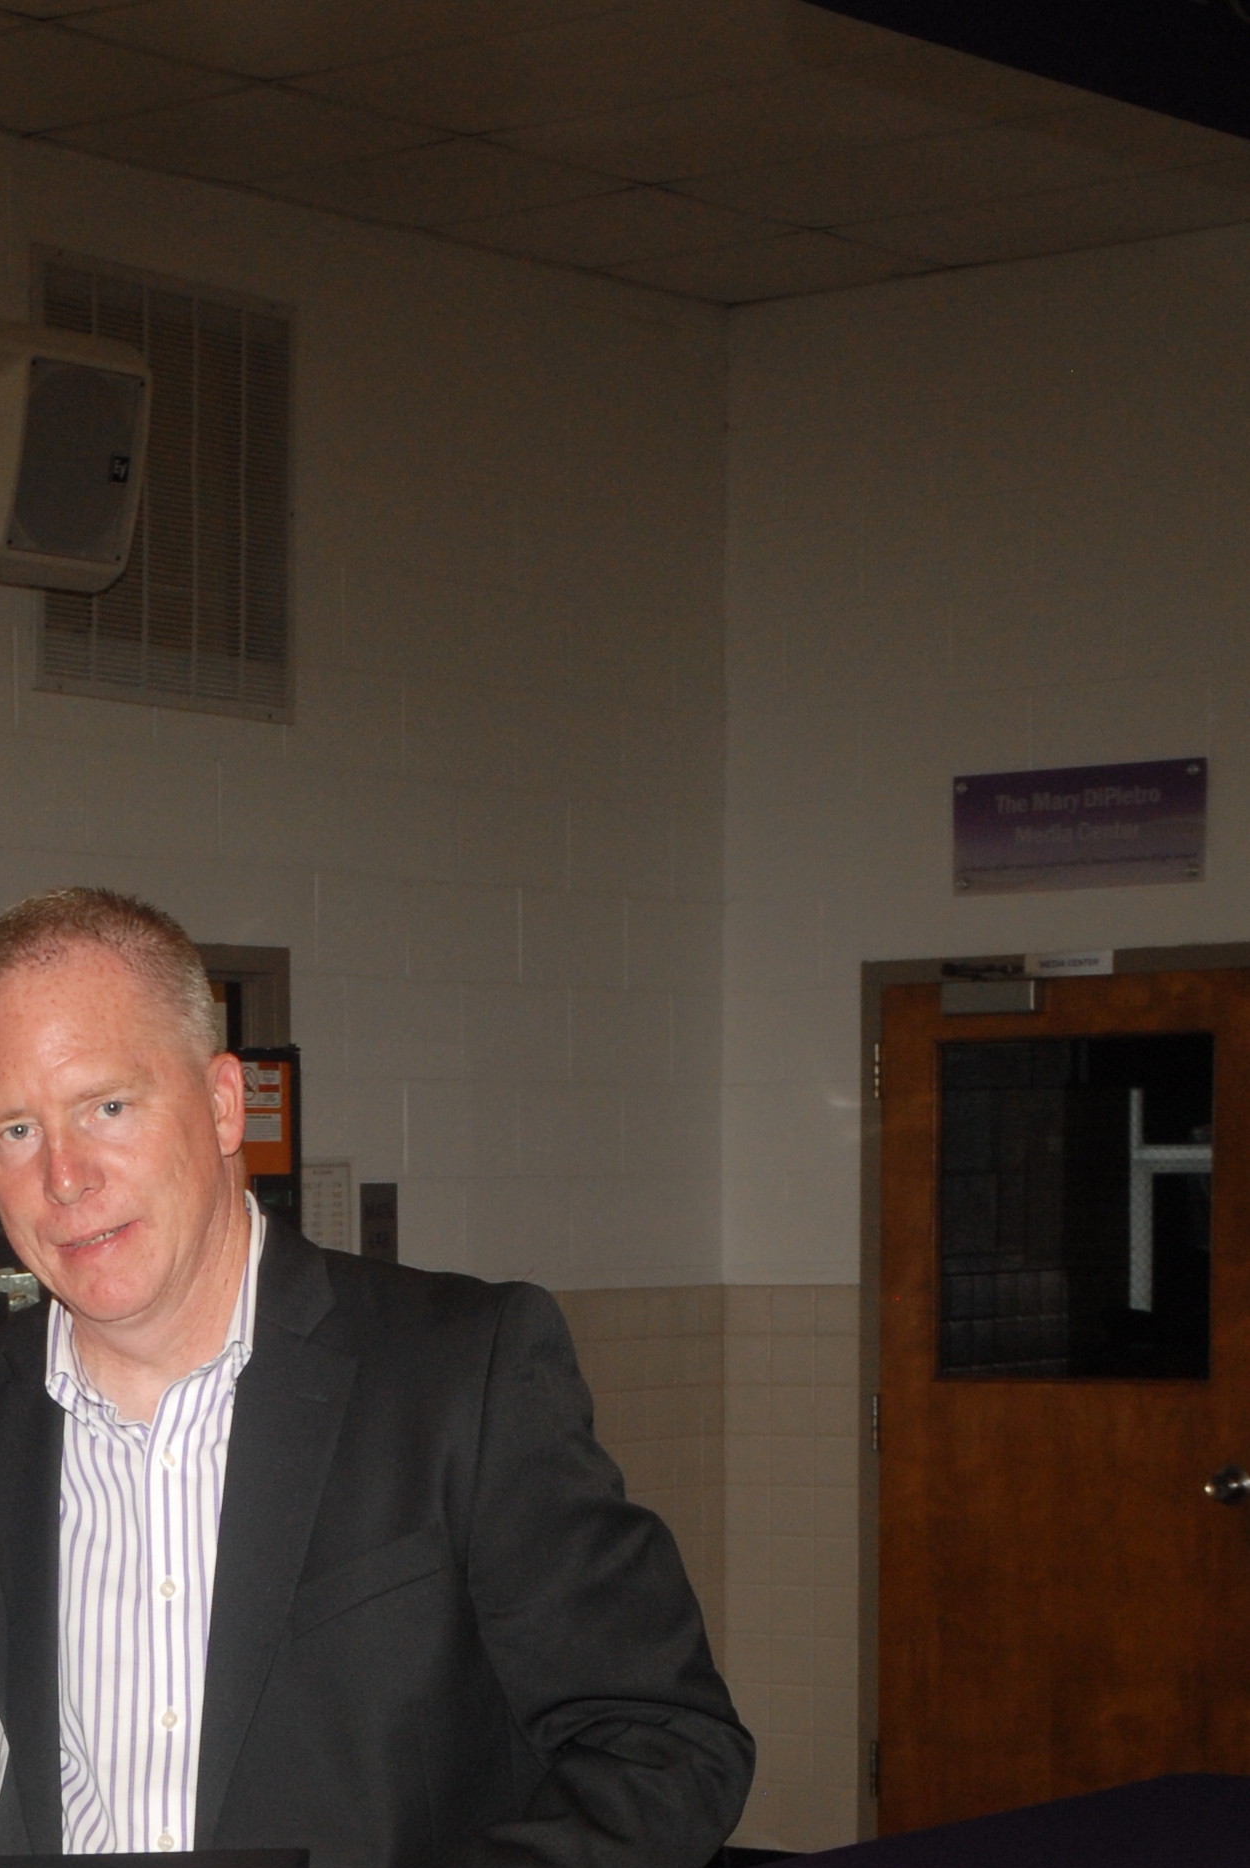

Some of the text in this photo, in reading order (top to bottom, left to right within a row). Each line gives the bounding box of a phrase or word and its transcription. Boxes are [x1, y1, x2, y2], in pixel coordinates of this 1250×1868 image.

[995, 785, 1162, 814] The Mary DiPietro
[1014, 823, 1073, 843] Media
